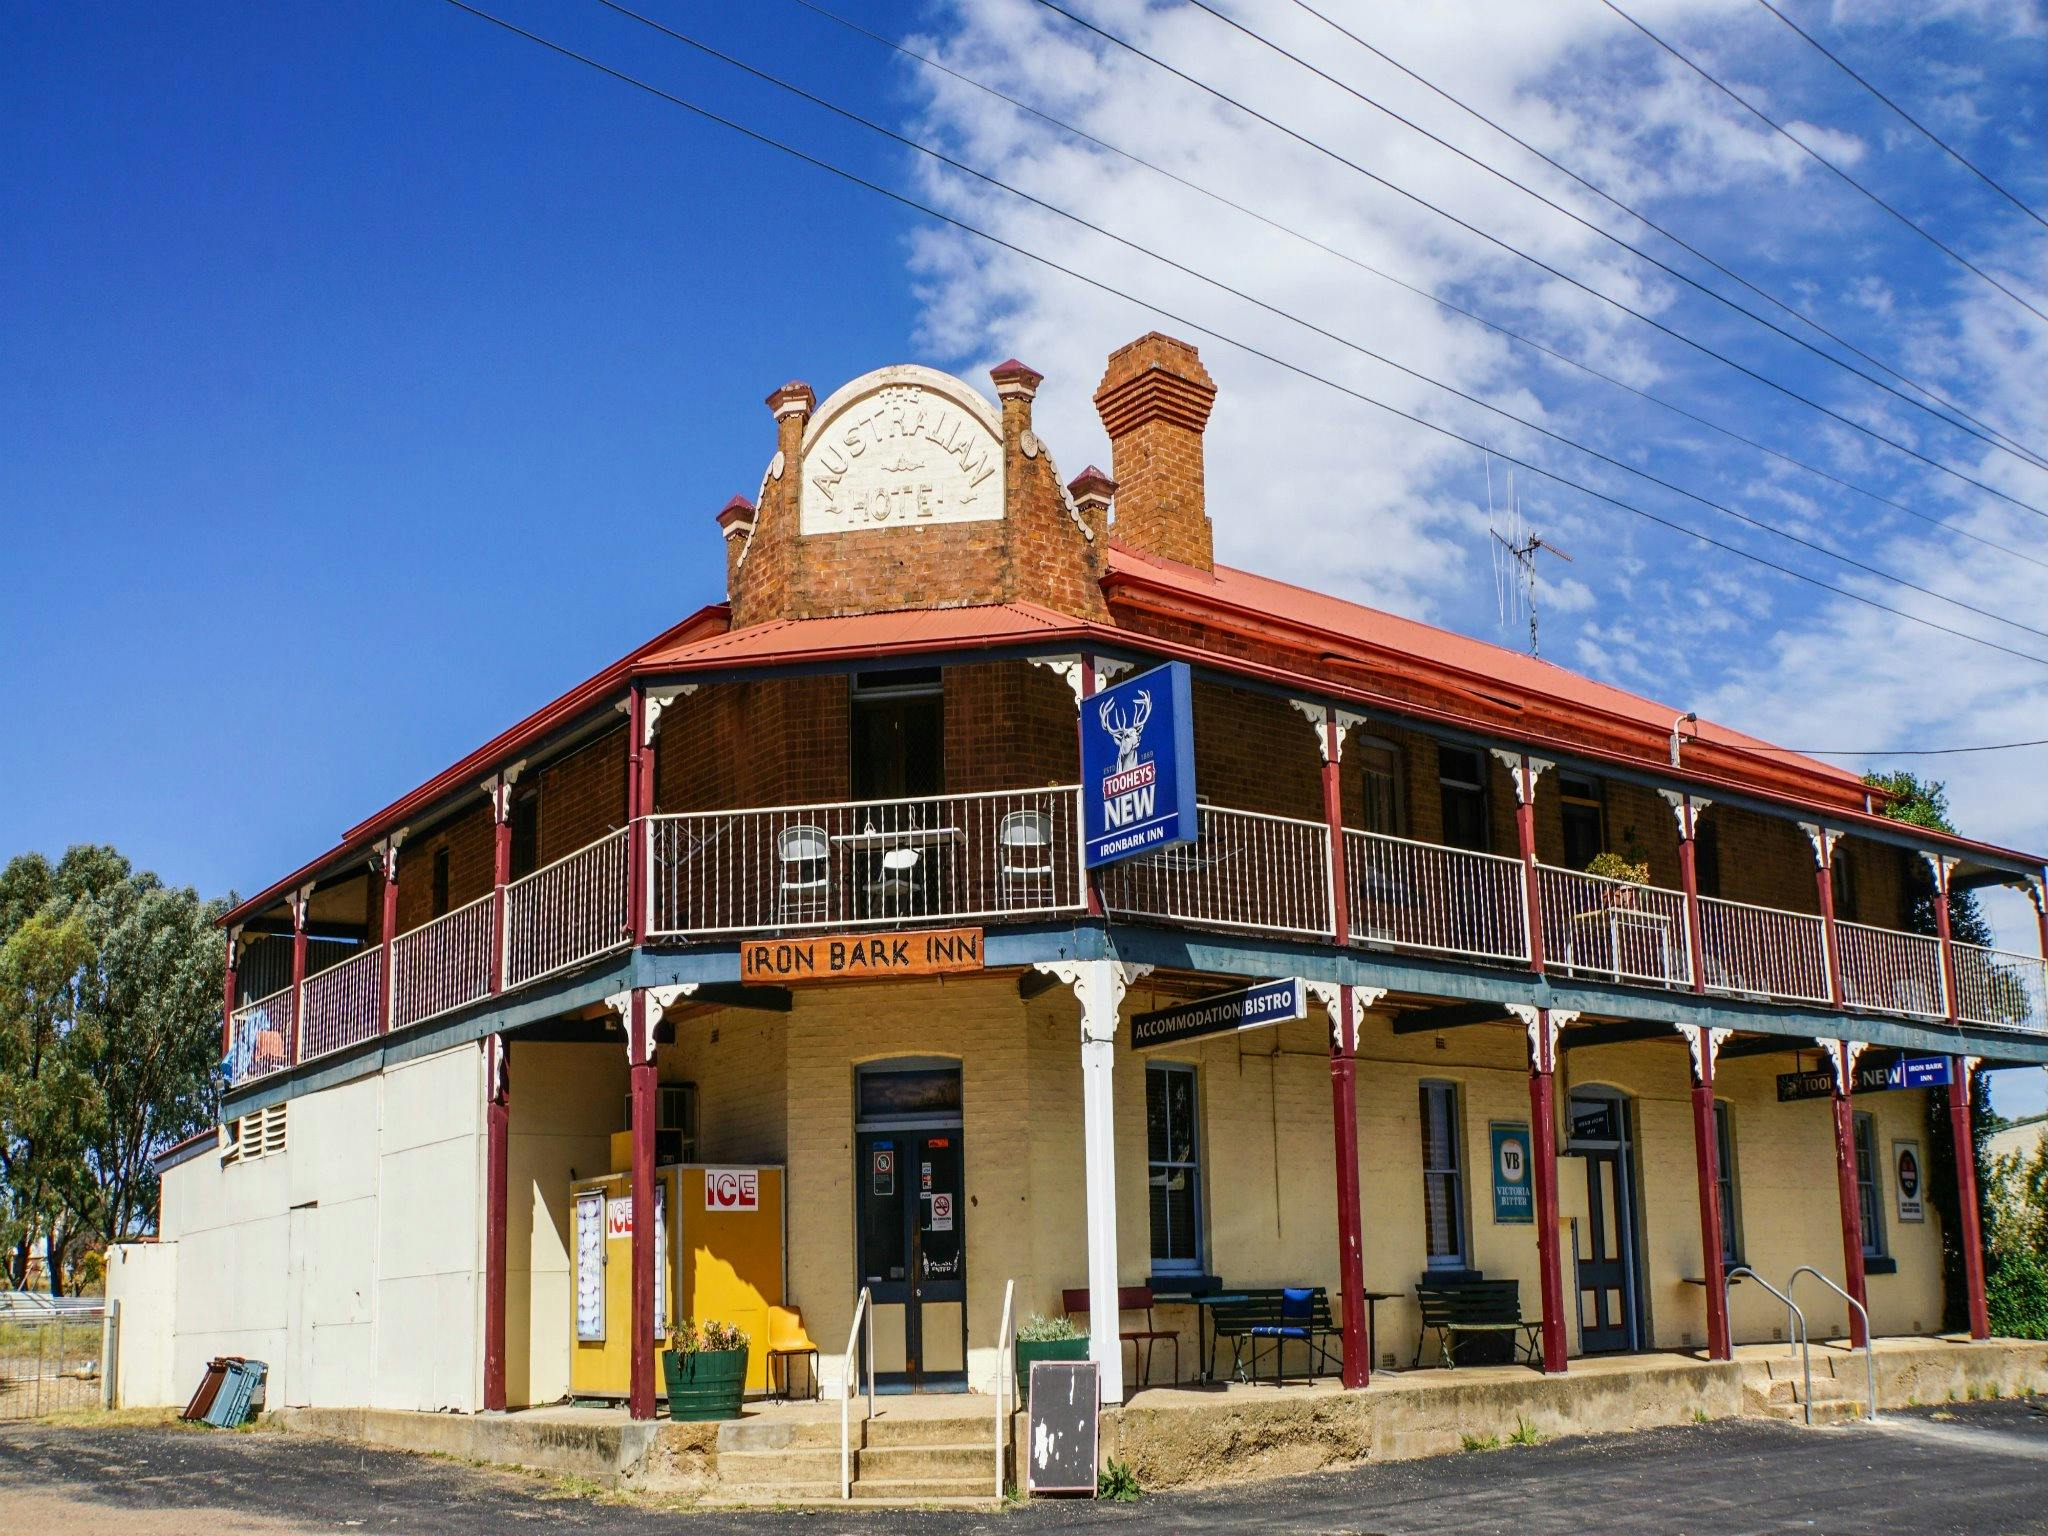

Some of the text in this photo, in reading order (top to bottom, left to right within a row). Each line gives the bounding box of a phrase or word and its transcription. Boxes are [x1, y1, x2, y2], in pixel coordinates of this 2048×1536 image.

[878, 386, 921, 405] THE
[811, 403, 994, 502] AUSTRALIAN
[1105, 765, 1153, 795] TOOHEYS
[1103, 784, 1156, 831] NEW
[1100, 826, 1164, 857] IRONBARK INN
[747, 934, 977, 975] IRON BARK INN
[1862, 1066, 1901, 1087] NEW
[1908, 1062, 1943, 1073] IRON BARK
[1920, 1074, 1933, 1082] INN
[1504, 1152, 1520, 1170] VB
[707, 1174, 756, 1206] ICE
[1496, 1187, 1530, 1196] VICTORIA
[1501, 1196, 1527, 1206] BITTER
[609, 1201, 633, 1233] ICE
